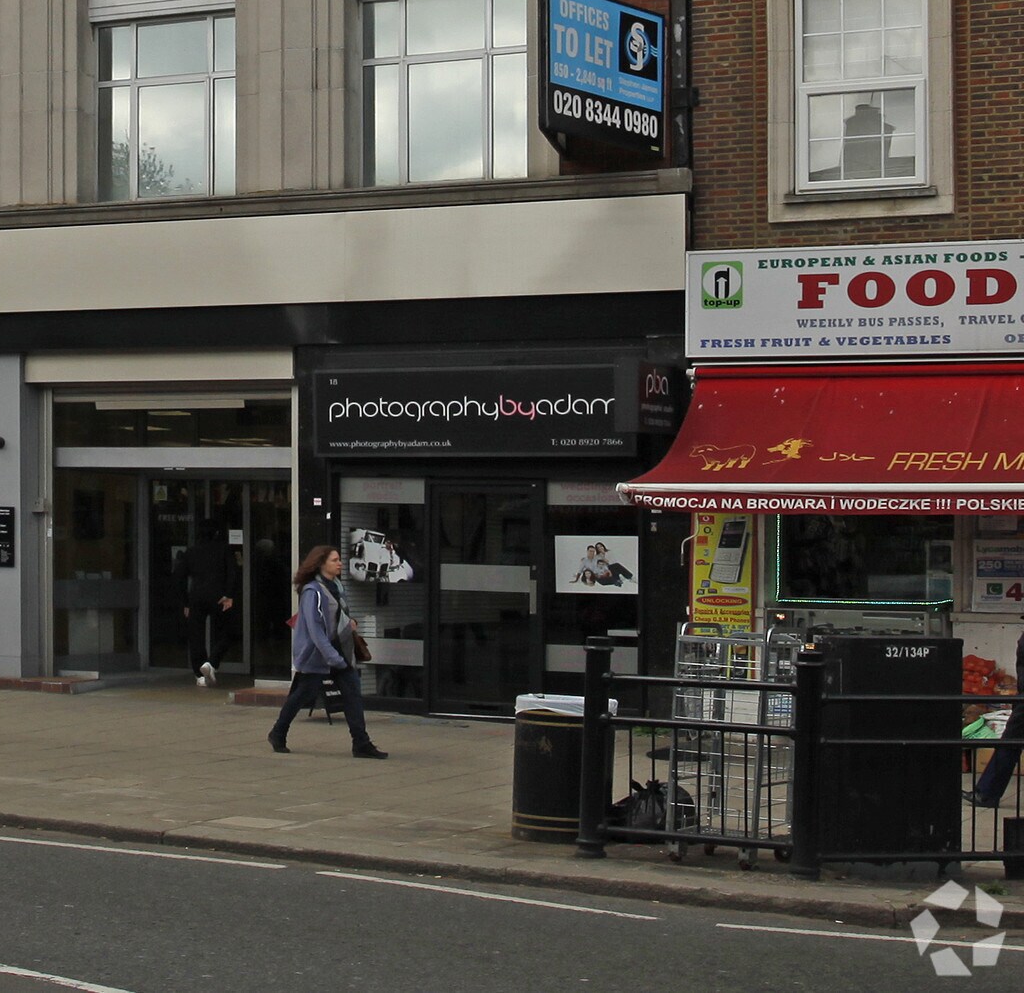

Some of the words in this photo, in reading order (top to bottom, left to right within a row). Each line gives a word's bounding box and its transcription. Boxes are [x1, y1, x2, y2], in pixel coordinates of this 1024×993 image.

[554, 23, 578, 58] TO
[585, 32, 613, 69] LET
[553, 89, 582, 119] 020
[585, 98, 621, 129] 8344
[624, 108, 658, 139] 0980
[758, 256, 857, 269] EUROPEAN
[862, 256, 876, 266] &
[881, 253, 938, 265] ASIAN
[943, 251, 1008, 263] FOODS
[797, 268, 1017, 310] FOOD
[704, 298, 741, 307] top-up
[797, 318, 854, 328] WEEKLY
[858, 317, 884, 327] BUS
[888, 316, 945, 328] PASSES,
[959, 314, 1015, 325] TRAVEL
[700, 338, 756, 348] FRESH
[760, 337, 812, 347] FRUIT
[818, 336, 831, 347] &
[835, 334, 952, 346] VEGETABLES
[329, 393, 616, 423] photographybyadam
[329, 440, 452, 449] www.photographybyadam.co.uk
[560, 438, 576, 446] 020
[578, 438, 600, 446] 8920
[602, 438, 624, 446] 7866
[886, 452, 988, 471] FRESH
[634, 494, 718, 510] PROMOCJA
[721, 498, 743, 510] NA
[746, 498, 827, 510] BROWARA
[839, 498, 931, 510] WODECZKE
[978, 560, 1002, 569] 250
[886, 647, 930, 657] 32/134P
